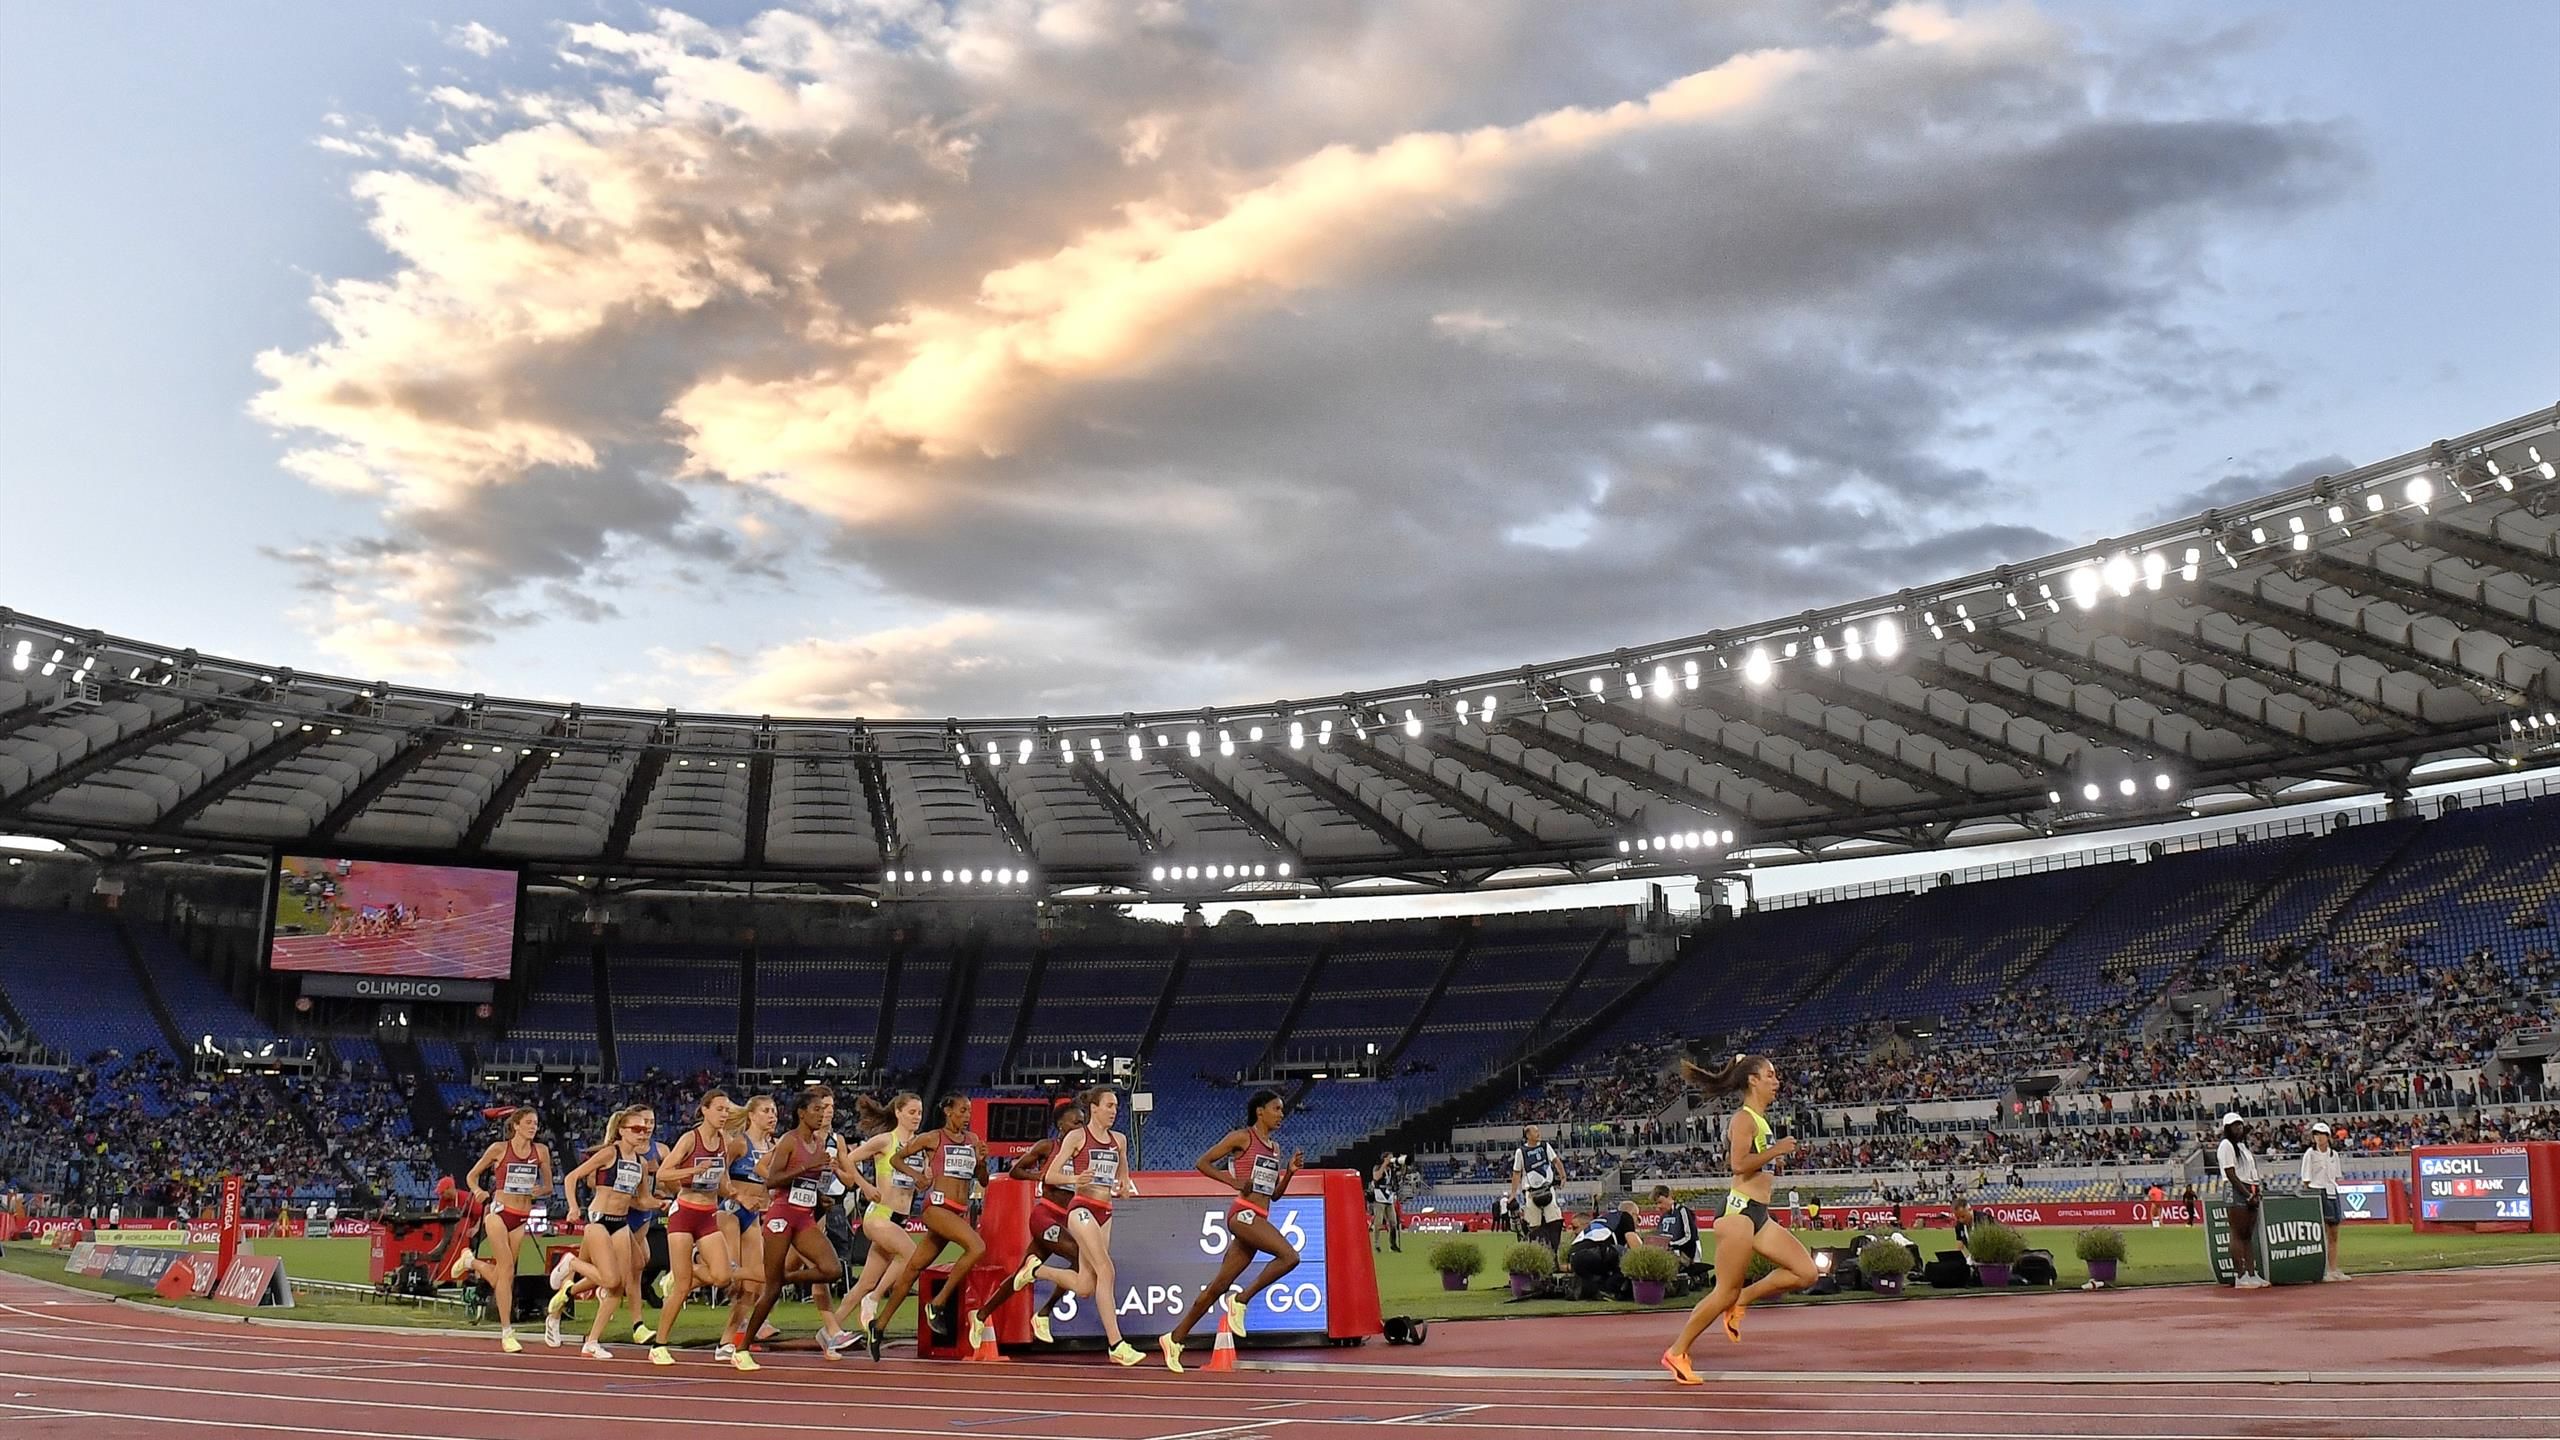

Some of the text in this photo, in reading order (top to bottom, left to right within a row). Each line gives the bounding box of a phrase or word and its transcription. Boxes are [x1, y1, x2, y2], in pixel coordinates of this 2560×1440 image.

[356, 980, 441, 996] OLIMPICO
[2422, 1159, 2483, 1175] GASCH L
[2431, 1180, 2529, 1195] SUI RANK 4
[1730, 1196, 1742, 1208] 15
[2495, 1201, 2529, 1217] 2.15
[223, 1193, 236, 1230] OMEGA
[1078, 1211, 1090, 1222] 12
[1997, 1209, 2042, 1223] OMEGA
[2083, 1209, 2116, 1217] TIMEKEEPER
[43, 1221, 84, 1232] OMEGA
[772, 1221, 781, 1230] 3
[1637, 1215, 1661, 1226] OMEG
[2267, 1221, 2322, 1245] ULIVETO
[2271, 1249, 2288, 1261] VIVI
[2296, 1243, 2323, 1257] FORMA
[232, 1263, 265, 1300] OMEGA
[1052, 1289, 1078, 1321] 3
[1265, 1283, 1322, 1313] GO
